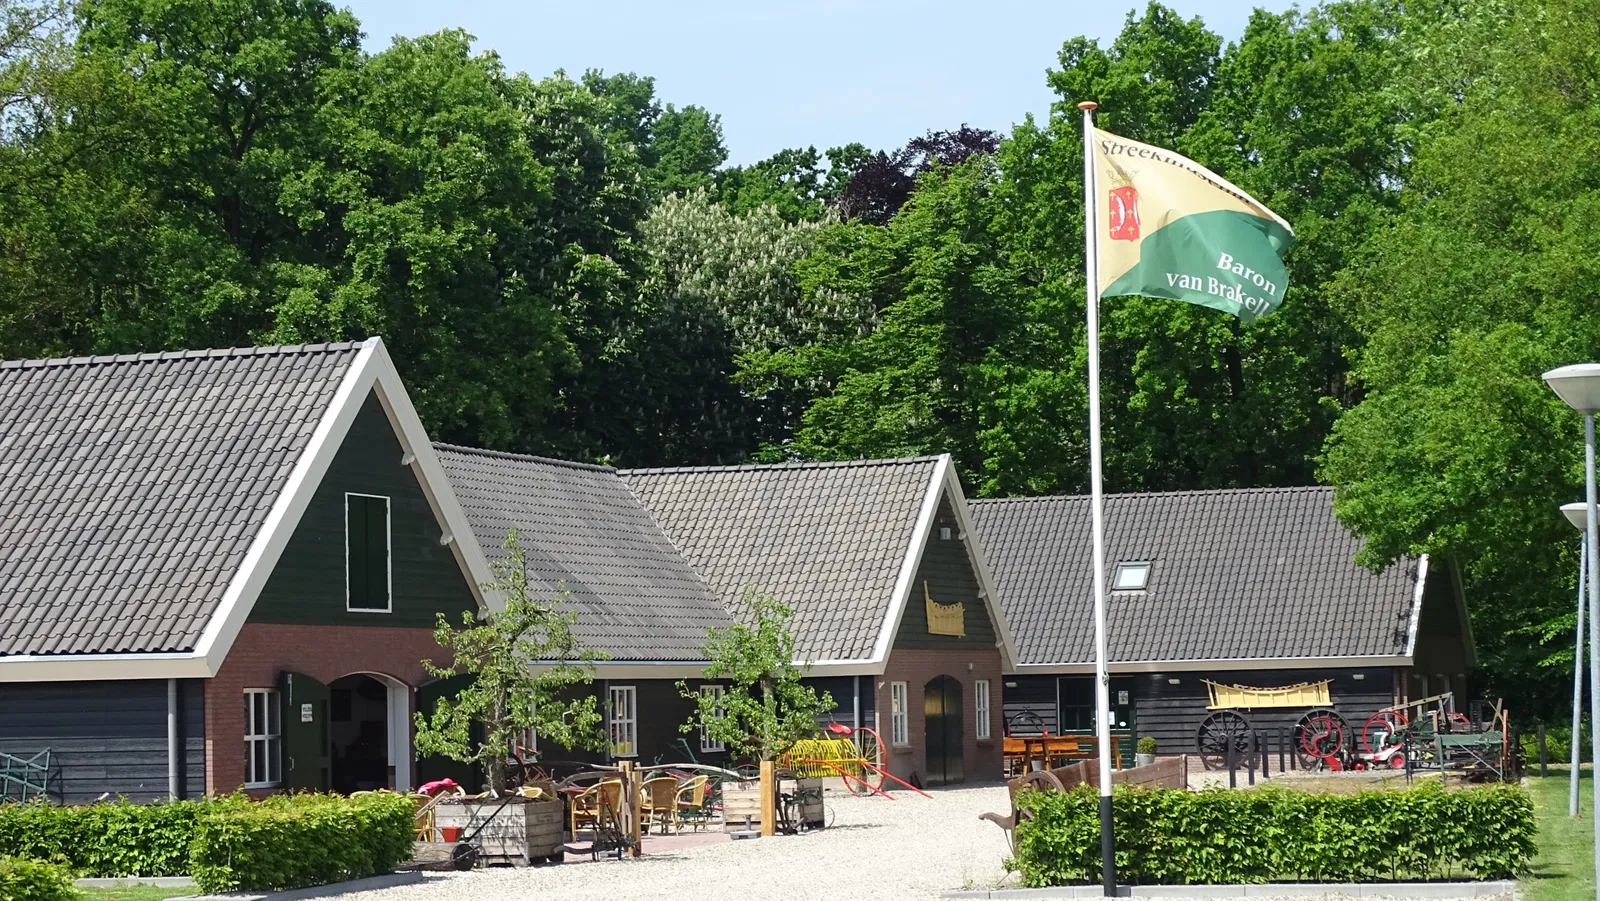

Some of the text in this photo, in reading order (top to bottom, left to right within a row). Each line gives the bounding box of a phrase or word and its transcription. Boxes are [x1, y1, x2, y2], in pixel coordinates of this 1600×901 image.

[1166, 273, 1270, 316] van Brakell
[1216, 252, 1277, 296] Baron
